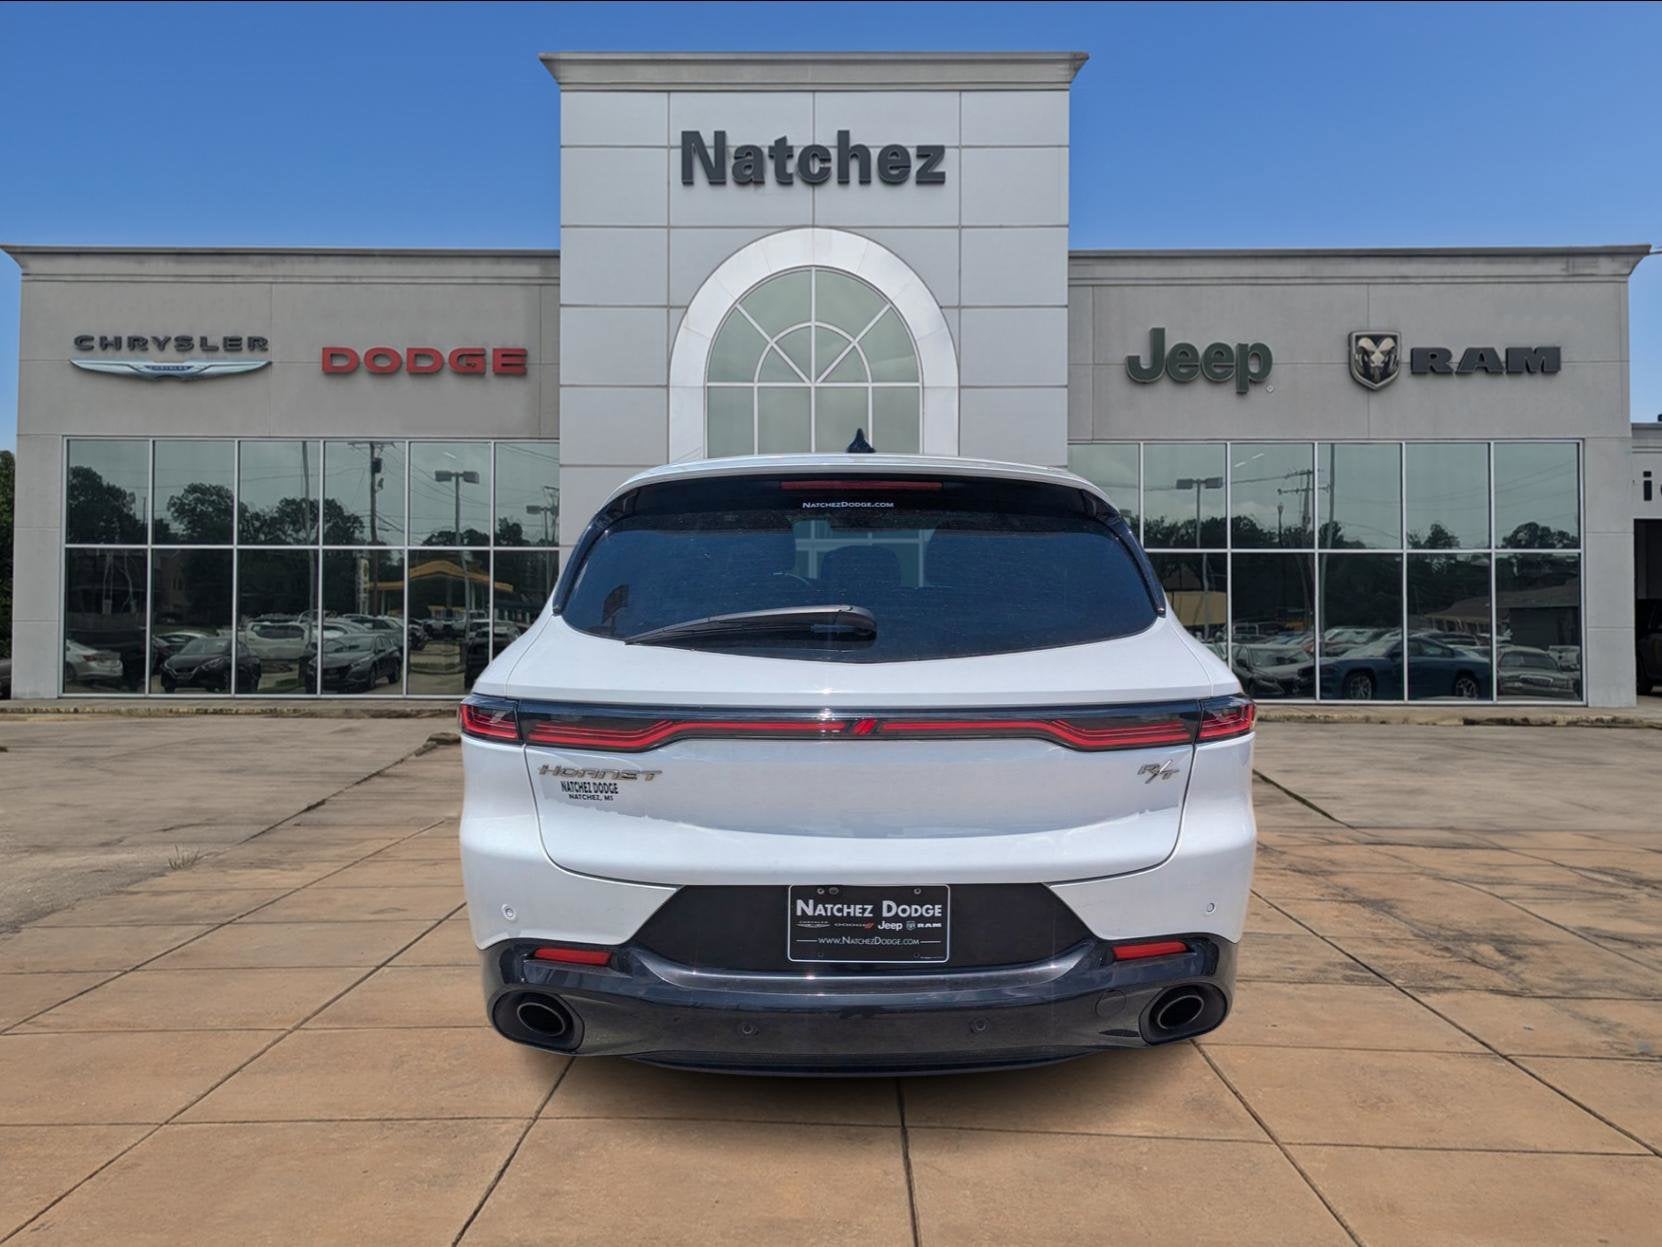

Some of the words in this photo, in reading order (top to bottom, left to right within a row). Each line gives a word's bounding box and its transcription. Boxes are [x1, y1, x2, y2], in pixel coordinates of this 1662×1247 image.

[681, 130, 946, 186] Natchez
[73, 334, 269, 352] CHRYSLER
[321, 346, 528, 375] DODGE
[1125, 327, 1273, 394] Jeep
[1409, 346, 1562, 376] RAM
[537, 764, 663, 781] HORNET
[1137, 759, 1180, 784] R/T
[560, 781, 592, 793] NATCHEZ
[592, 782, 619, 794] DODGE
[568, 793, 602, 801] NATCHEZ,
[796, 899, 874, 917] NATCHEZ
[882, 900, 942, 917] DODGE
[878, 920, 903, 931] Jeep
